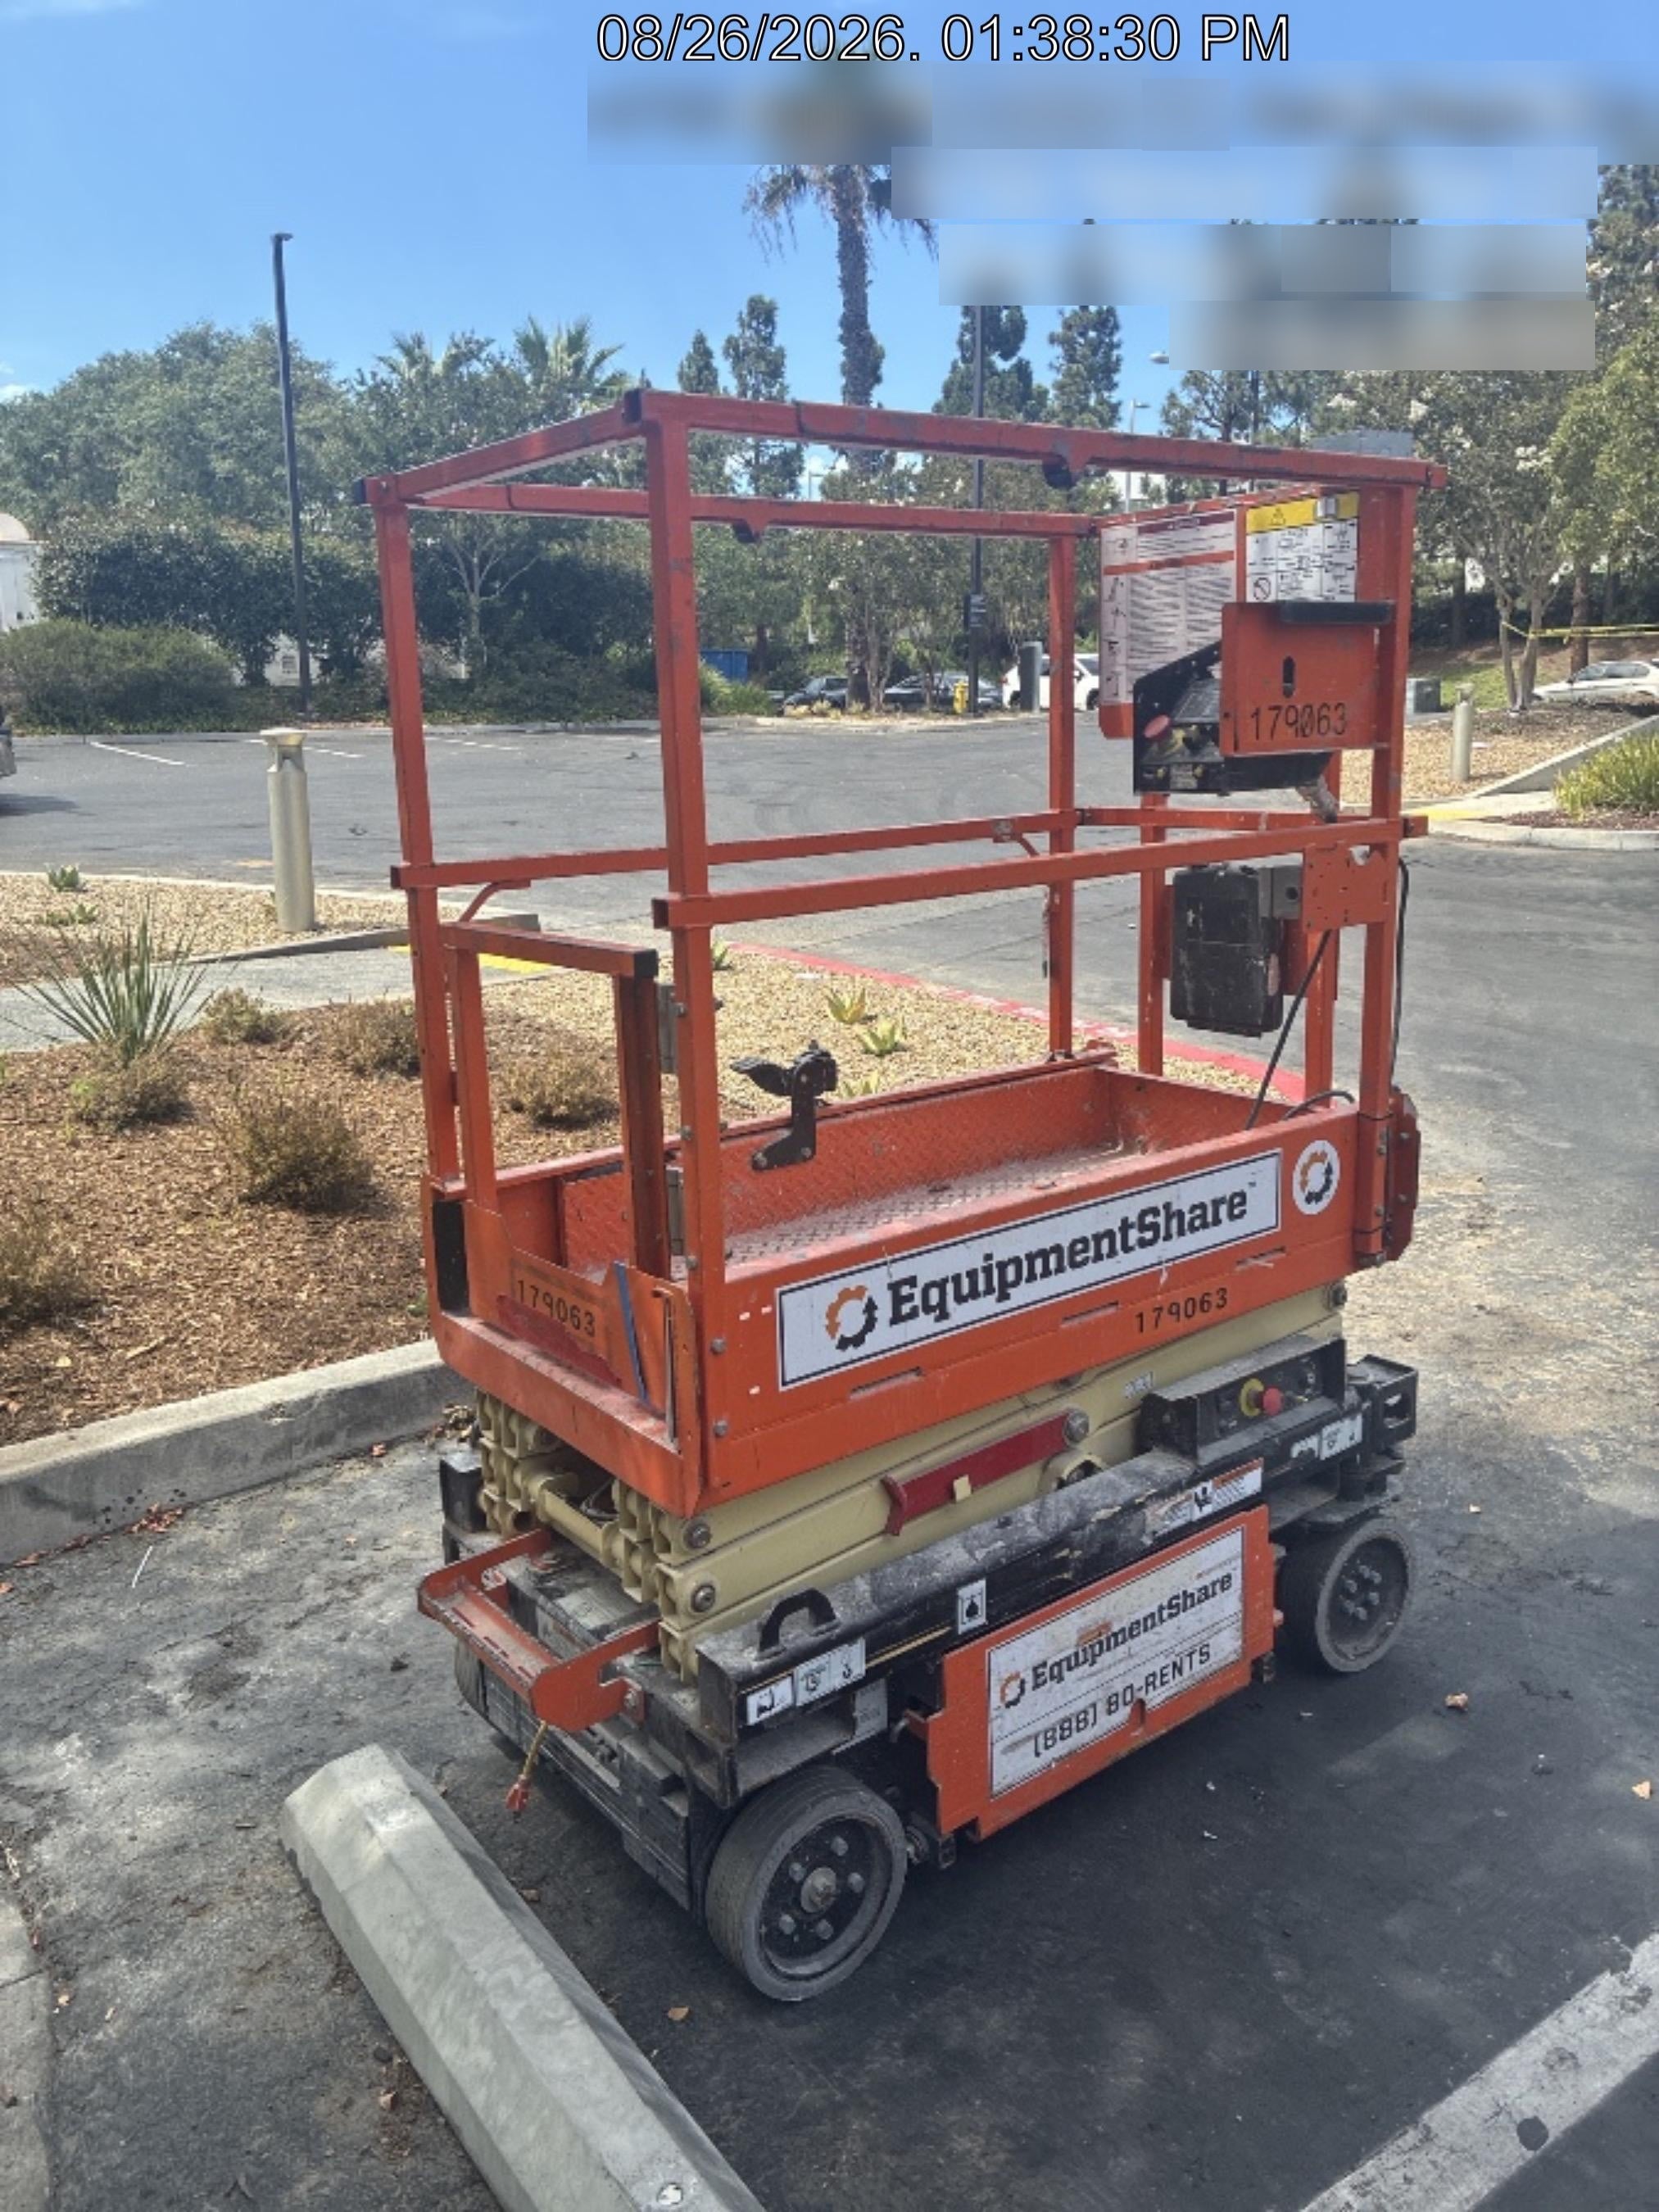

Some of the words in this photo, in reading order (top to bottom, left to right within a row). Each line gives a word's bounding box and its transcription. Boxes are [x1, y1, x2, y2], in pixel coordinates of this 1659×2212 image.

[1251, 702, 1347, 741] 179063
[517, 1280, 596, 1338] 179063
[1135, 1287, 1227, 1333] 179063
[1031, 1573, 1232, 1691] EquipmentShare
[1107, 1643, 1211, 1716] 80-RENTS
